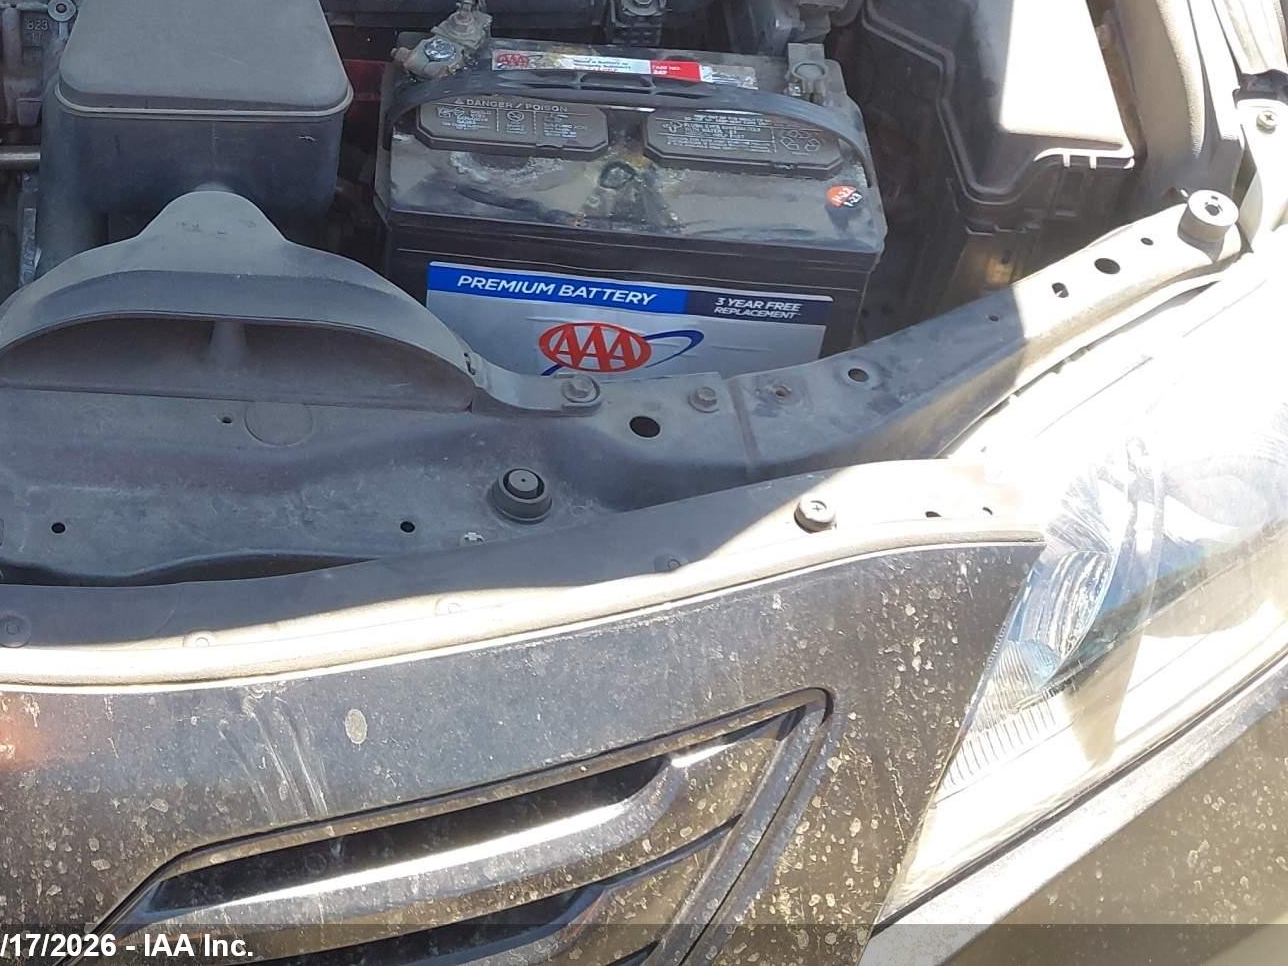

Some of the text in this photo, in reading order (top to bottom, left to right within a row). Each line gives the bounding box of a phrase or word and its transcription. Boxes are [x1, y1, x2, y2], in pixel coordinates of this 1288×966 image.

[466, 98, 512, 109] DANGER
[525, 103, 568, 113] POISON
[457, 275, 657, 306] PREMIUM BATTERY
[715, 297, 803, 312] 3 YEAR FREE
[713, 306, 797, 319] REPLACEMENT
[545, 323, 648, 372] AAA
